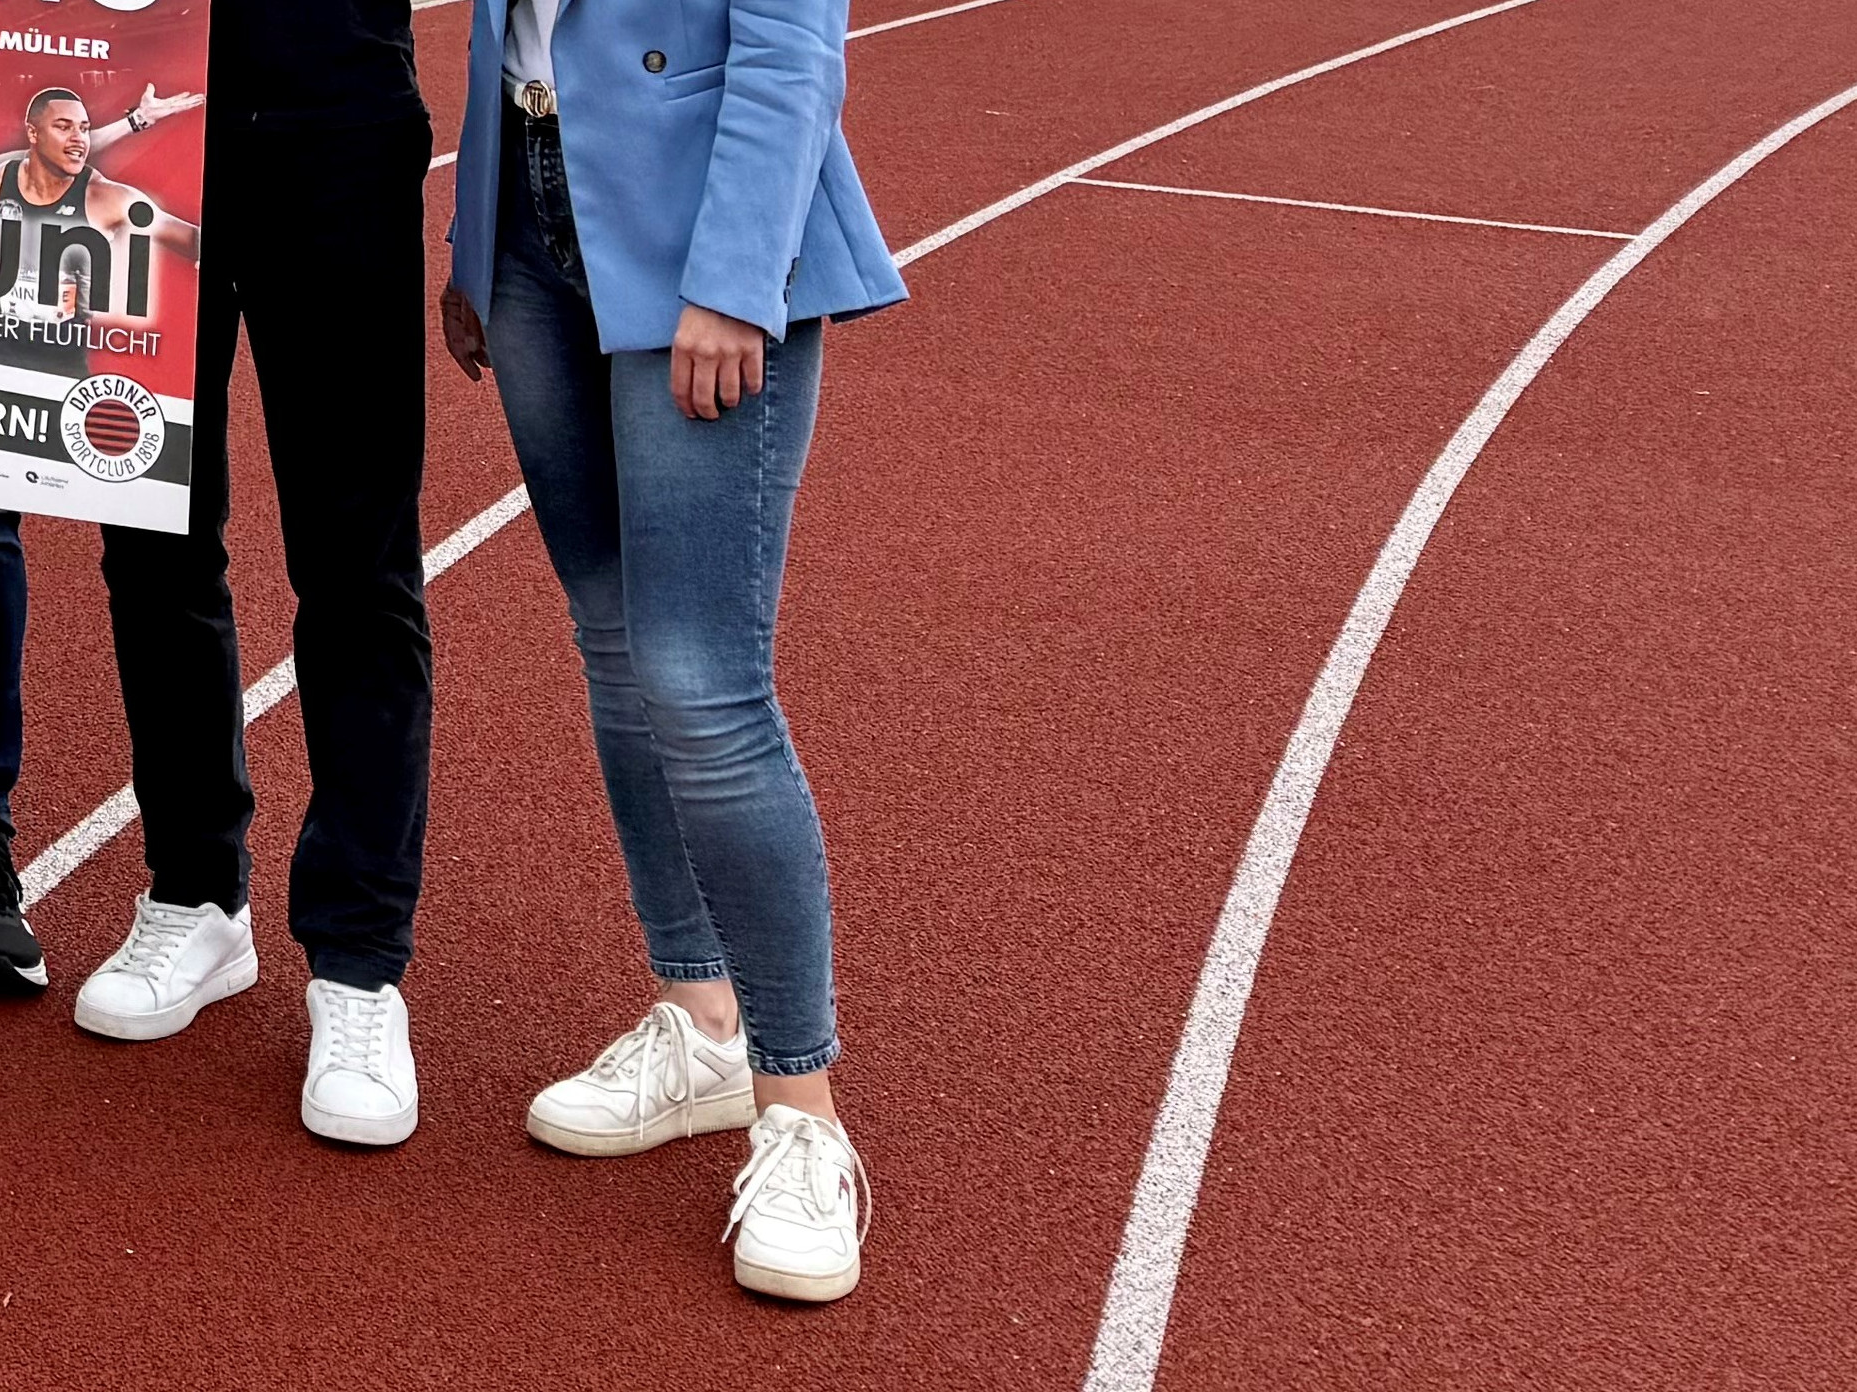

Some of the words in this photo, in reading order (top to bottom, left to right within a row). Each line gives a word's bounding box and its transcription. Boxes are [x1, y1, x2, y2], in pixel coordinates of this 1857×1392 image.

[30, 319, 162, 356] FLUTLICHT
[69, 378, 157, 420] DRESDNER
[65, 422, 136, 477] SPORTCLUB
[135, 432, 160, 466] 1898
